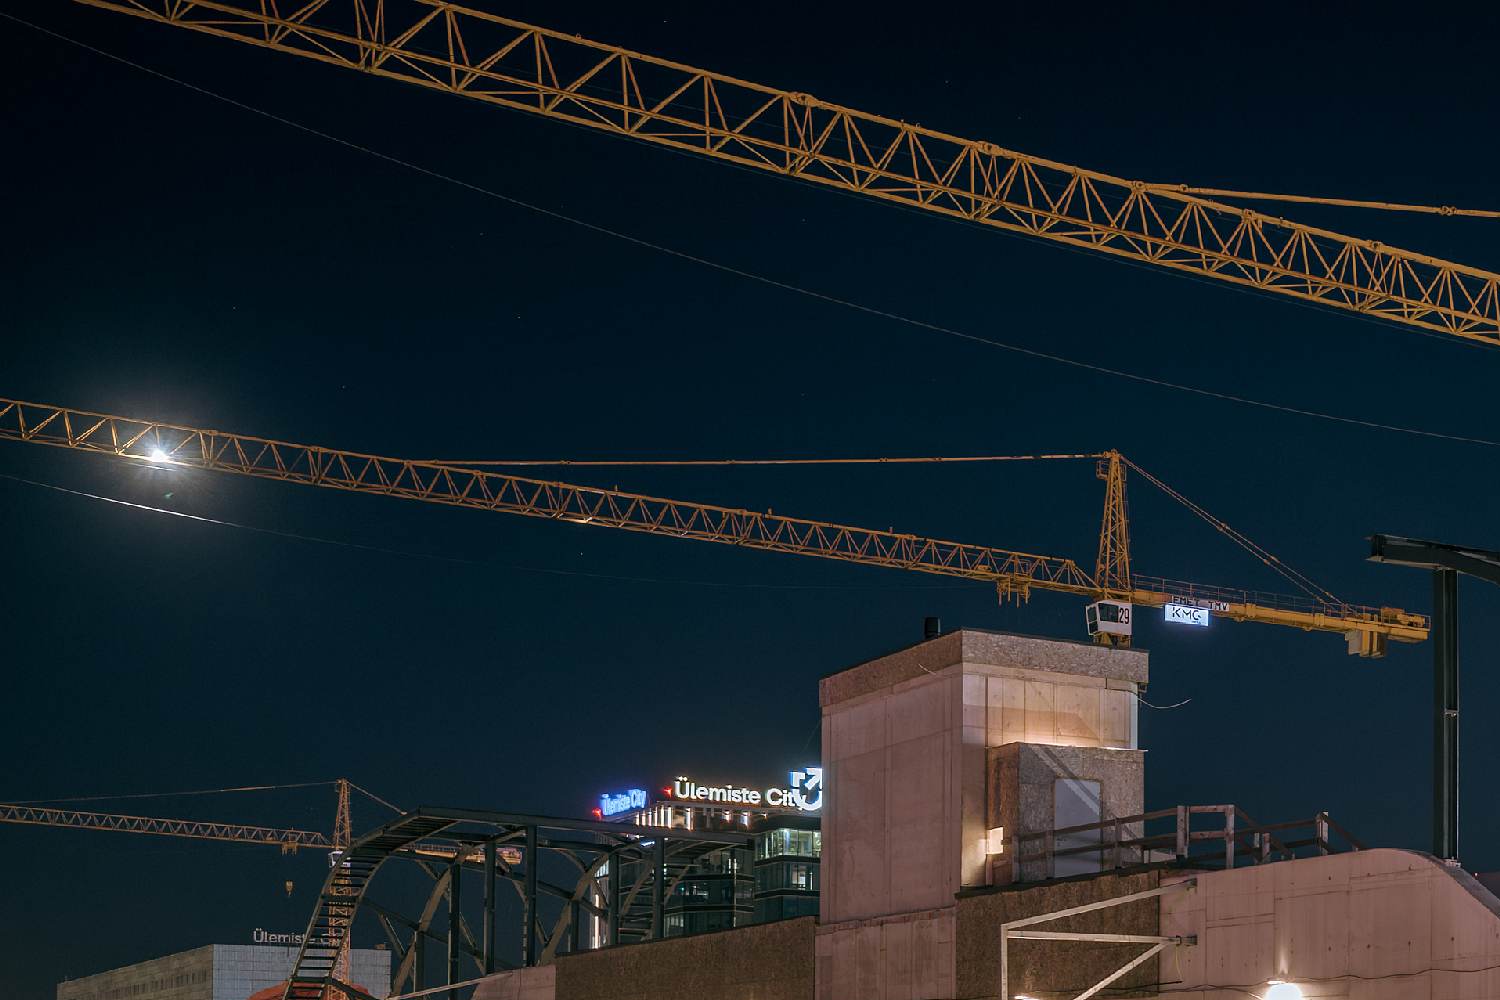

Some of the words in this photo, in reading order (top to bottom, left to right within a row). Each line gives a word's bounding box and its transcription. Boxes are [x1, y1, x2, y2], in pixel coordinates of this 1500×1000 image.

[1119, 607, 1130, 625] 29
[674, 776, 761, 804] Ülemiste
[766, 788, 806, 810] City
